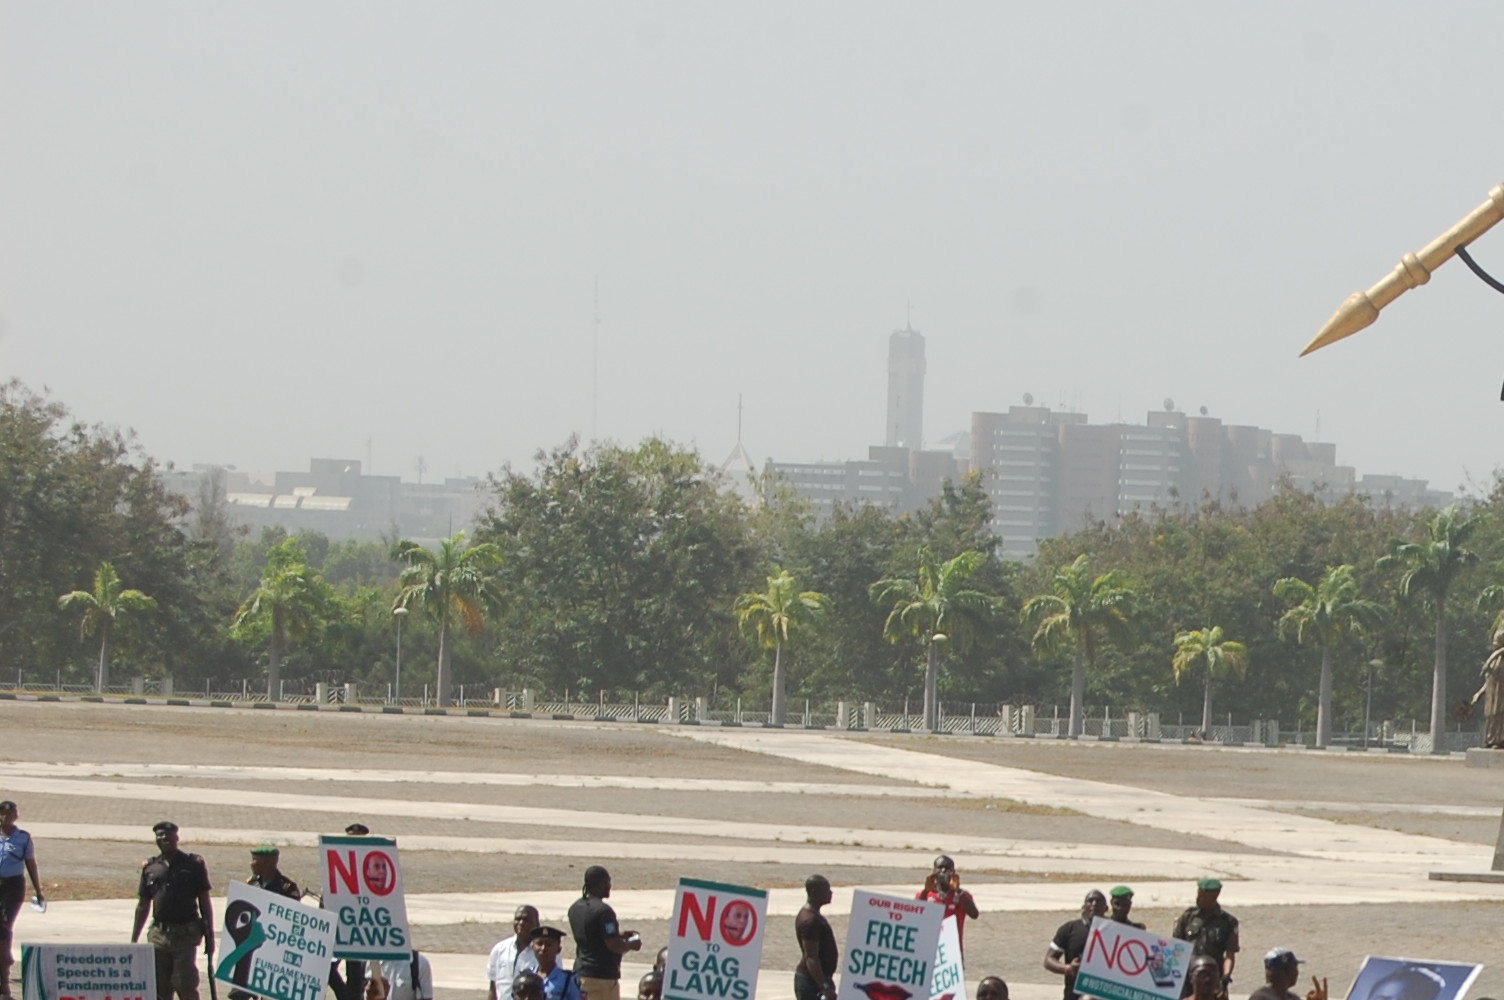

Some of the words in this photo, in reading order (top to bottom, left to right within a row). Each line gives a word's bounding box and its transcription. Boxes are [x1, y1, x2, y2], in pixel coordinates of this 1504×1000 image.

[327, 849, 396, 896] NO
[357, 896, 370, 905] TO
[869, 898, 891, 908] OUR
[893, 902, 925, 914] RIGHT
[268, 903, 329, 933] FREEDOM
[339, 907, 391, 926] GAG
[677, 892, 757, 947] NO
[889, 912, 902, 921] TO
[266, 923, 327, 957] Speech
[335, 927, 405, 947] LAWS
[706, 943, 720, 953] TO
[866, 920, 919, 953] FREE
[56, 954, 115, 965] Freedom
[119, 954, 133, 965] of
[682, 951, 739, 978] GAG
[1086, 928, 1149, 976] NO
[57, 968, 105, 979] Speech
[109, 968, 119, 978] is
[123, 970, 131, 978] a
[256, 958, 321, 986] FUNDAMENTAL
[848, 948, 927, 986] SPEECH
[58, 981, 146, 991] Fundamental
[670, 969, 750, 1000] LAWS
